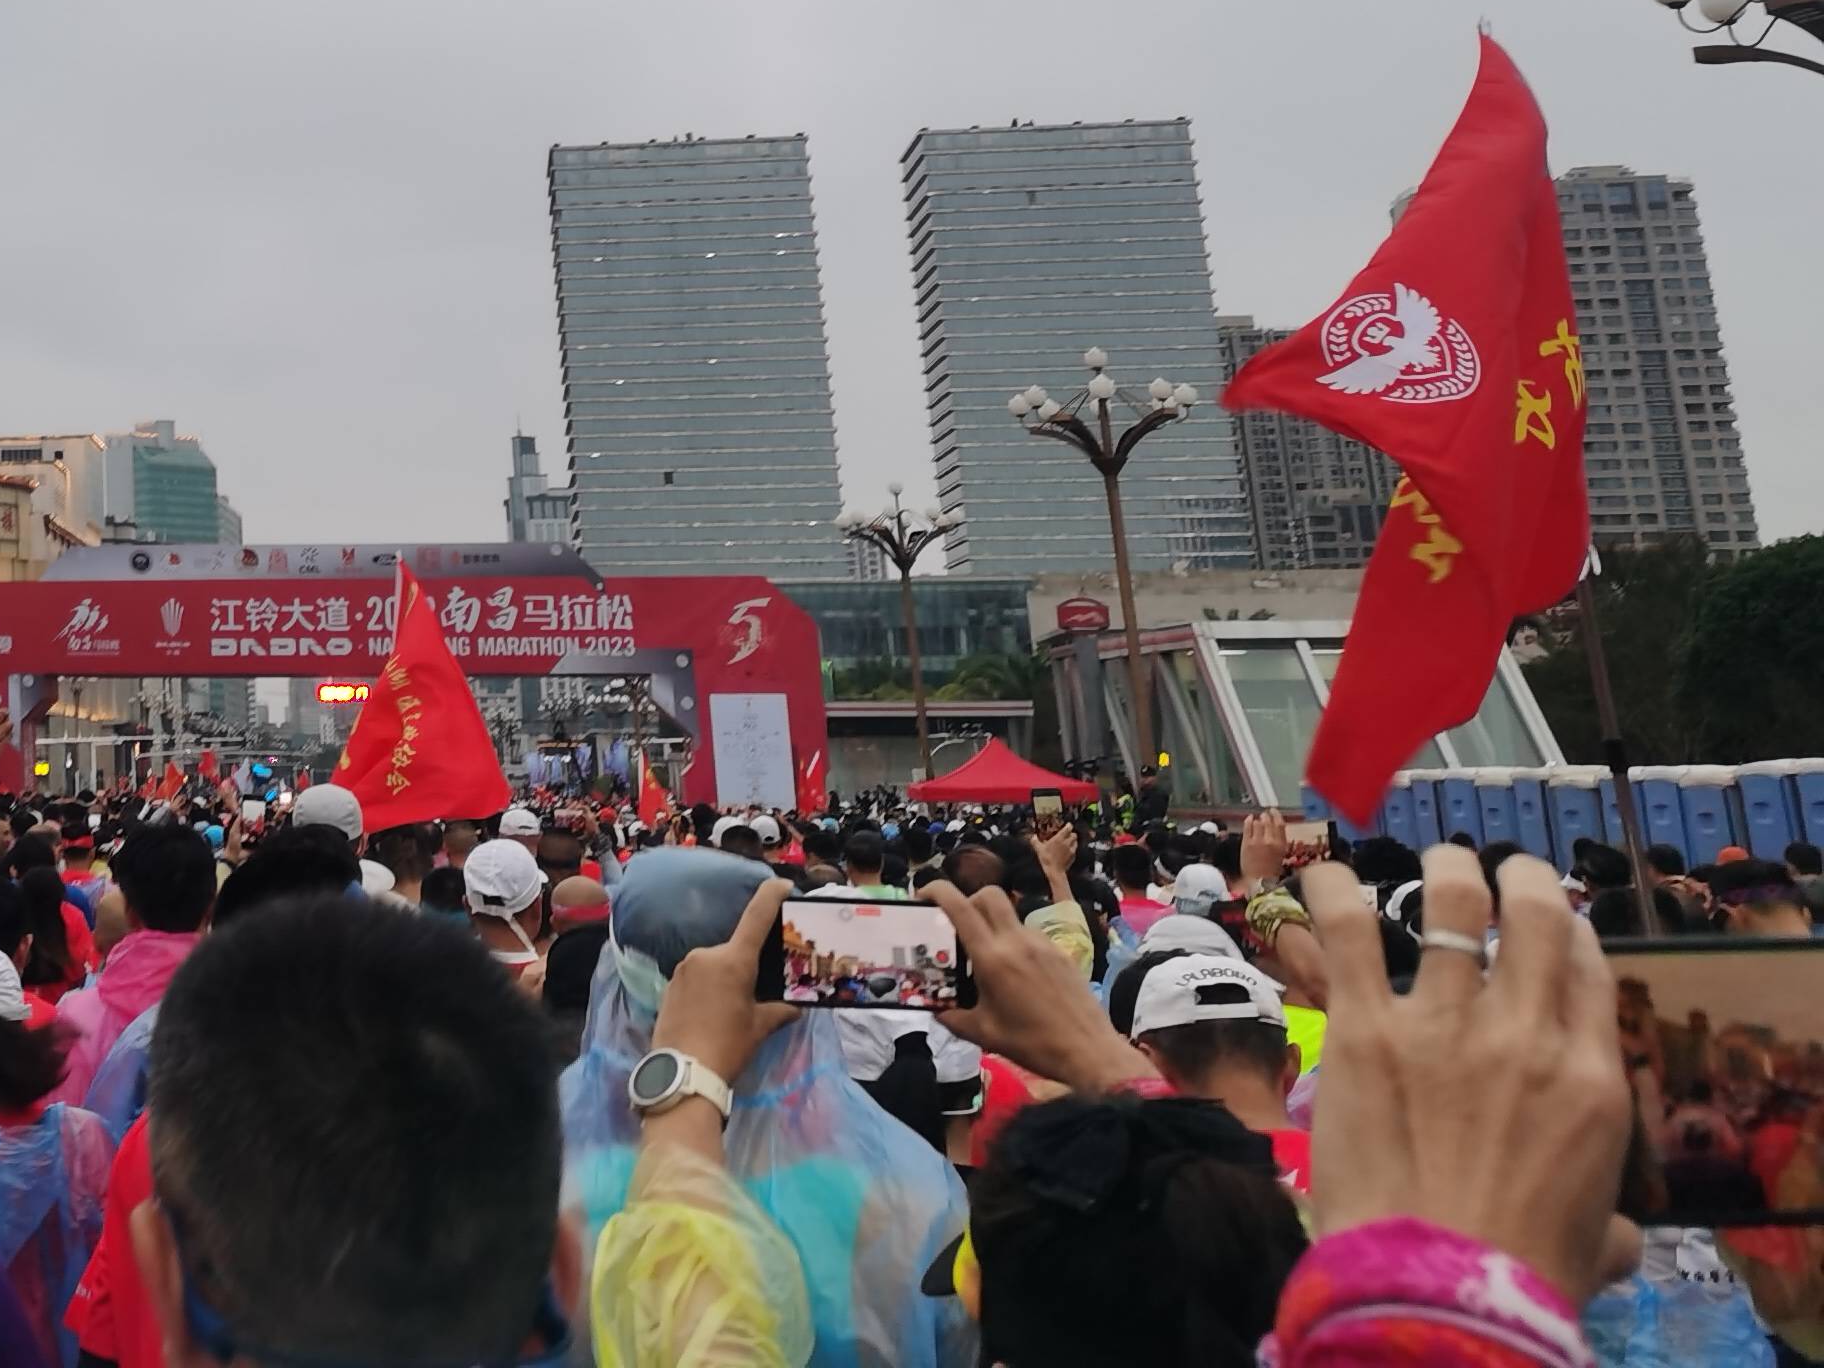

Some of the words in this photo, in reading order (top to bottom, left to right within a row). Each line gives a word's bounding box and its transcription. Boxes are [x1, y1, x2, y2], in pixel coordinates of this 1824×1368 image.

[210, 585, 634, 633] 江铃大道·20南昌马拉松
[478, 636, 577, 657] MARATHON
[584, 636, 637, 657] 2023
